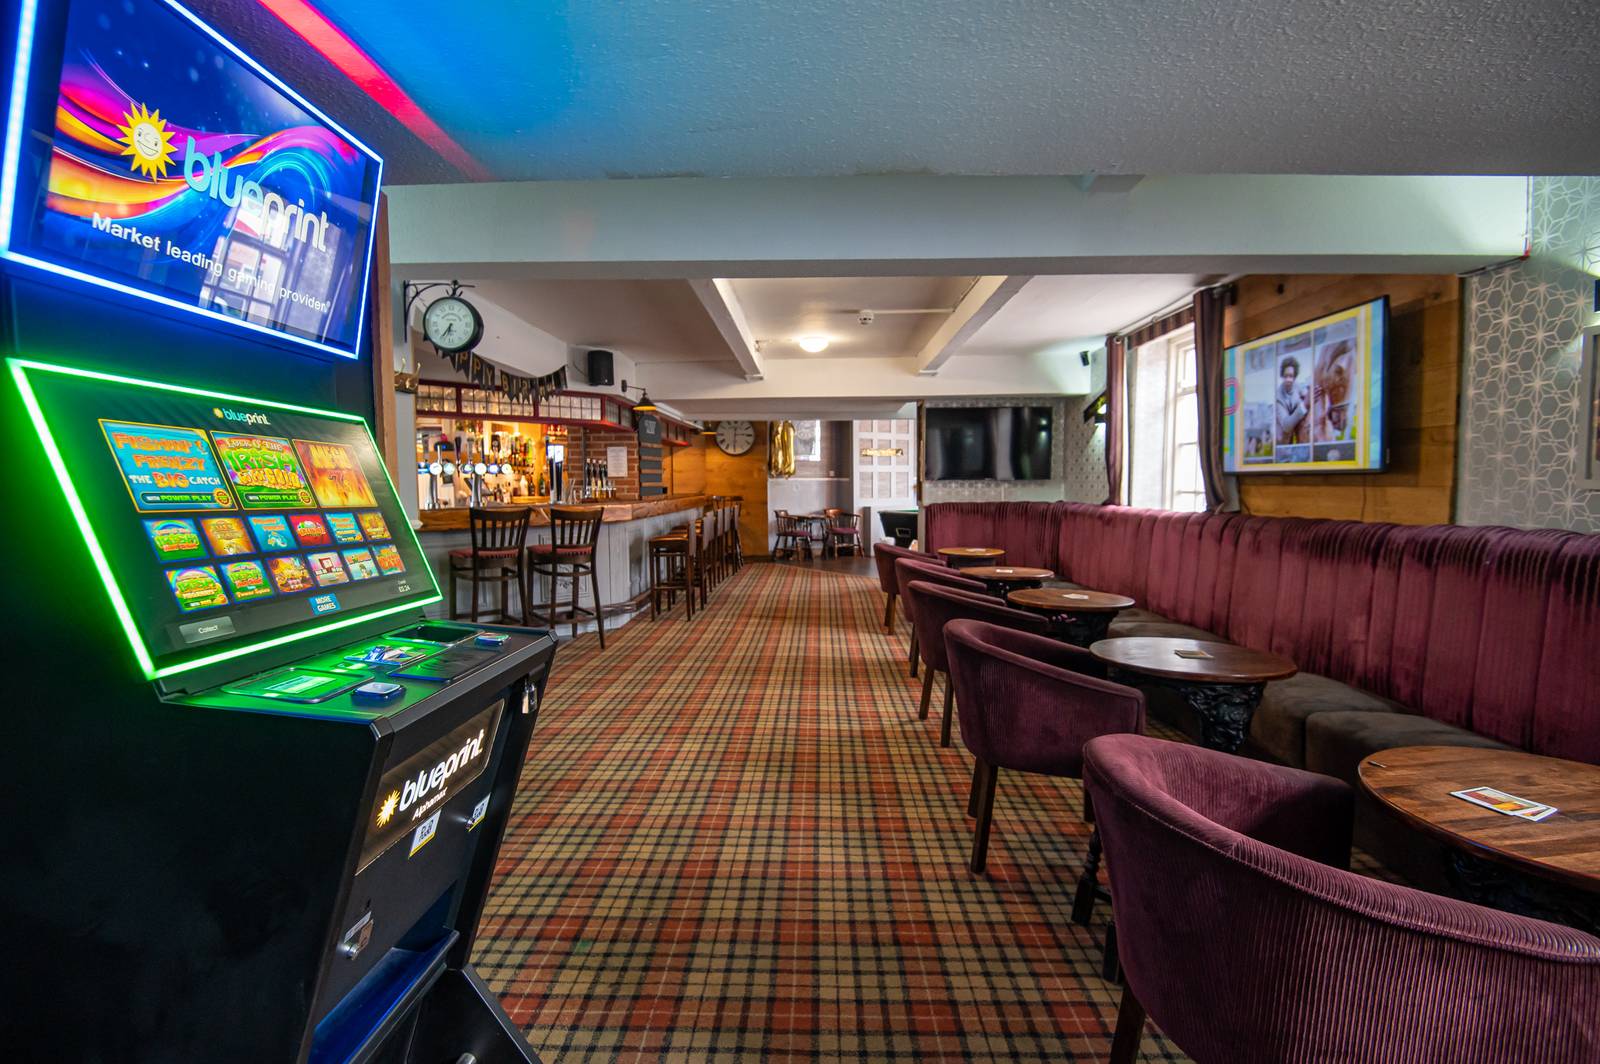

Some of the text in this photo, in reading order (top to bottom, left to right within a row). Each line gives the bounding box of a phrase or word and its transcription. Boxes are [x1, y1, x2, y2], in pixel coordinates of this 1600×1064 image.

[184, 135, 329, 252] blueprint
[92, 212, 160, 252] Market
[166, 240, 223, 277] leading
[228, 267, 277, 296] gaming
[222, 408, 271, 425] blueprint
[128, 471, 221, 488] THE BIG CATCH
[133, 454, 205, 471] FRENZY
[399, 729, 484, 812] blueprint
